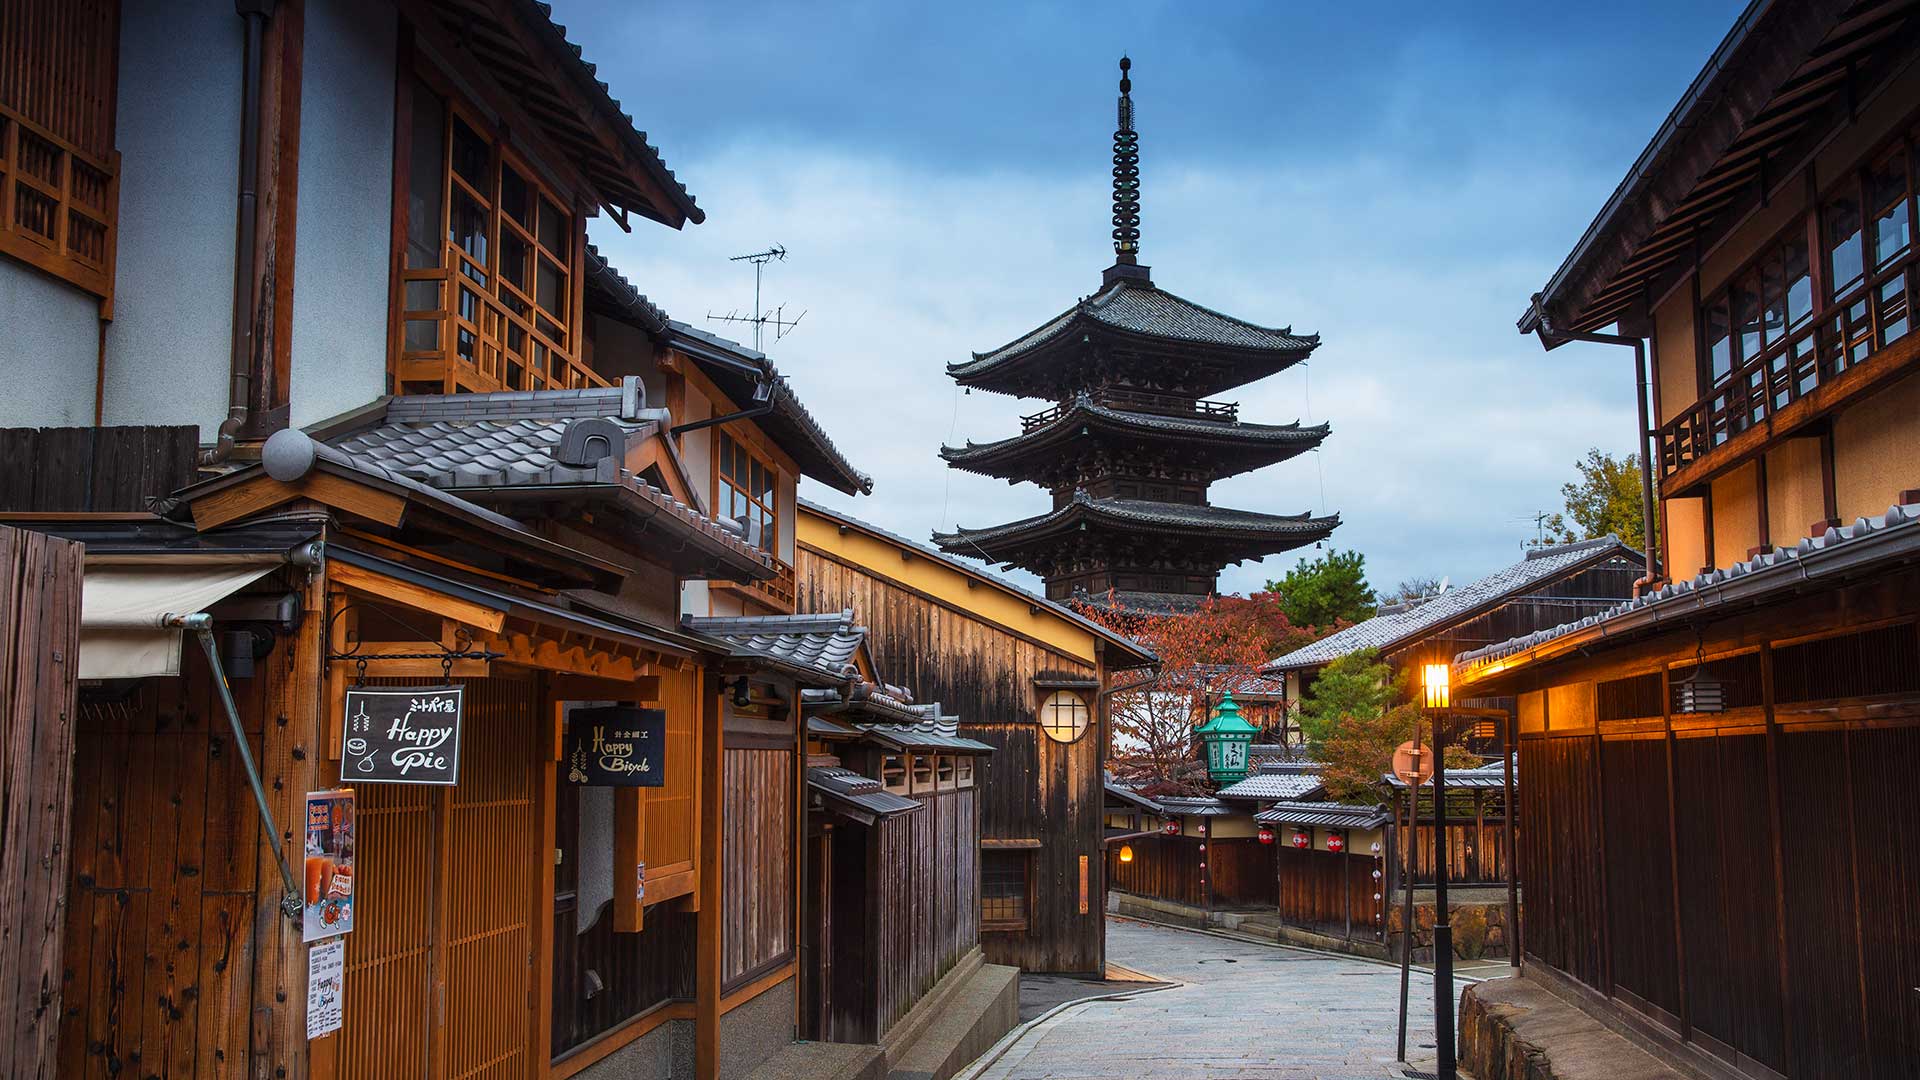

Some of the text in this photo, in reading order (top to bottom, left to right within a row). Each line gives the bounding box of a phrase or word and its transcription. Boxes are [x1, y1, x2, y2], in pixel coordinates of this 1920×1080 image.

[410, 696, 456, 713] ミートパイ屋
[387, 711, 453, 747] Happy
[592, 726, 633, 757] Happy
[391, 750, 448, 775] Pie
[599, 757, 650, 776] Bicycle
